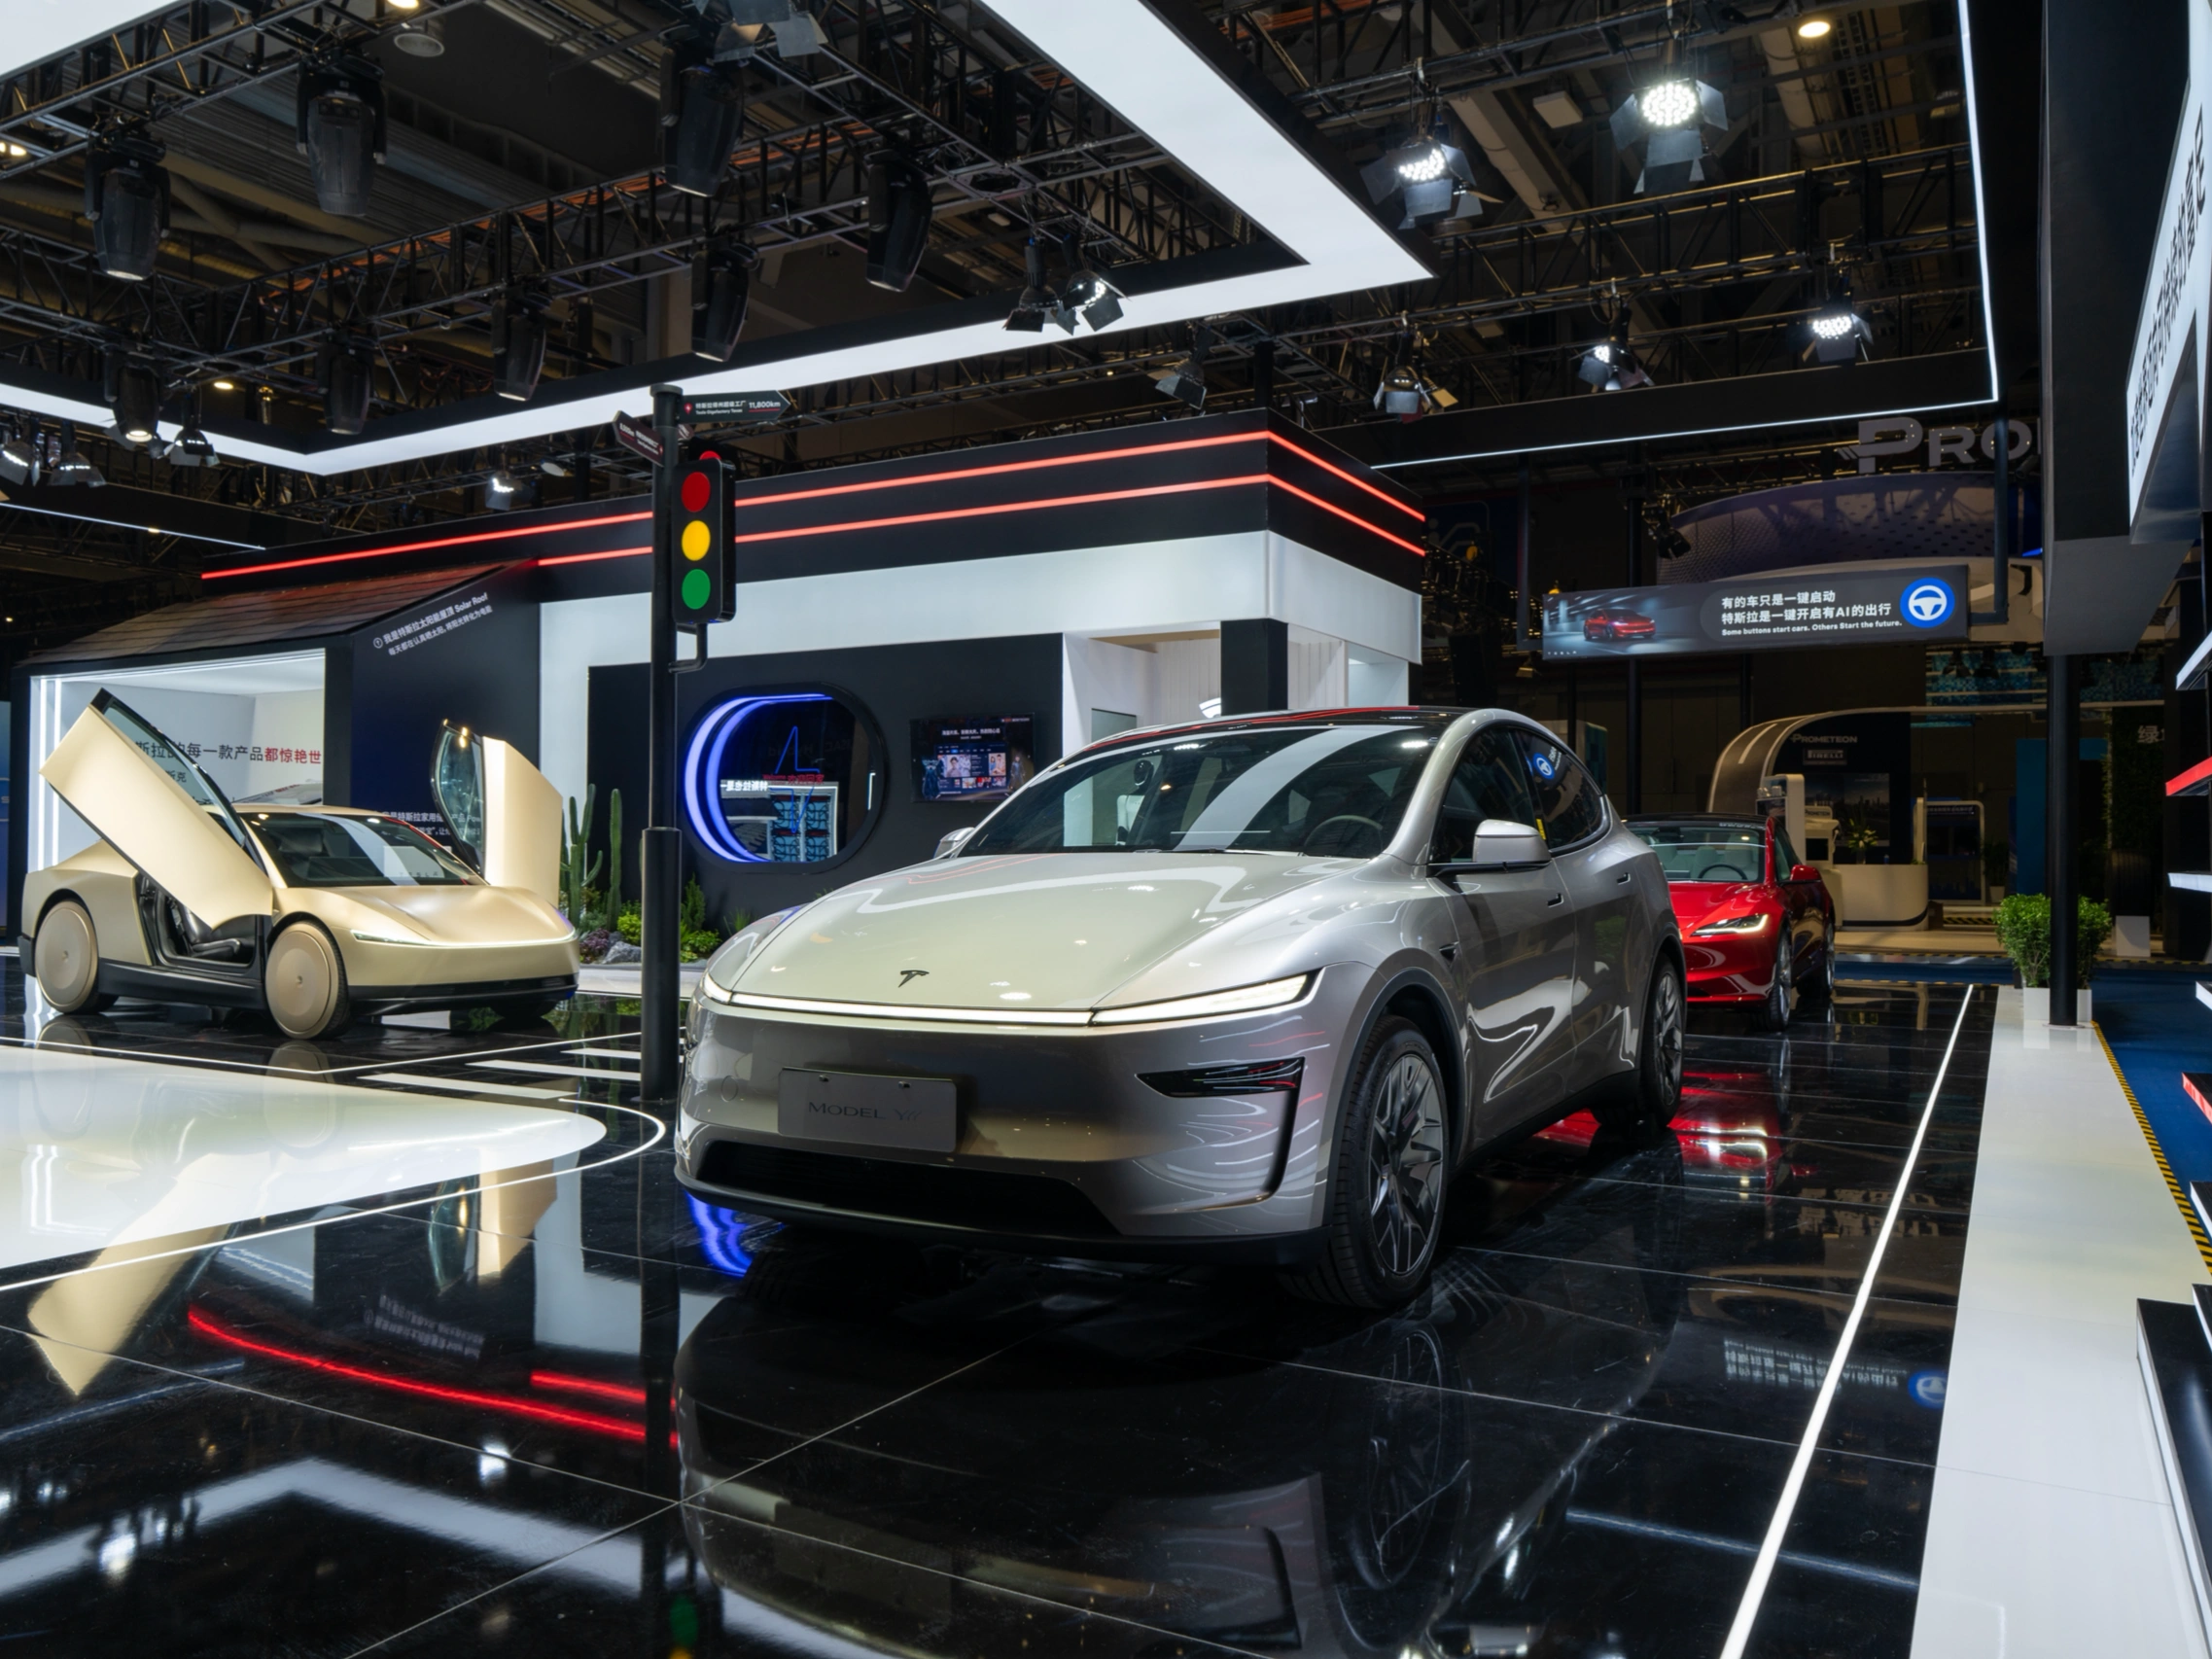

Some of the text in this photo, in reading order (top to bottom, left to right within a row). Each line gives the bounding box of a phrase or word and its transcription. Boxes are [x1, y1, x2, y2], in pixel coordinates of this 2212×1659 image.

[1837, 416, 2042, 474] PRO
[1721, 591, 1836, 610] 有的车只是一键启动
[383, 591, 488, 645] 我是特斯拉太阳能屋顶 Solar Roof
[1721, 603, 1892, 625] 特斯拉是一键开启有AI的出行
[1791, 733, 1858, 744] PROMETEON
[1808, 749, 1843, 759] PIRELLI
[808, 1101, 887, 1119] MODEL
